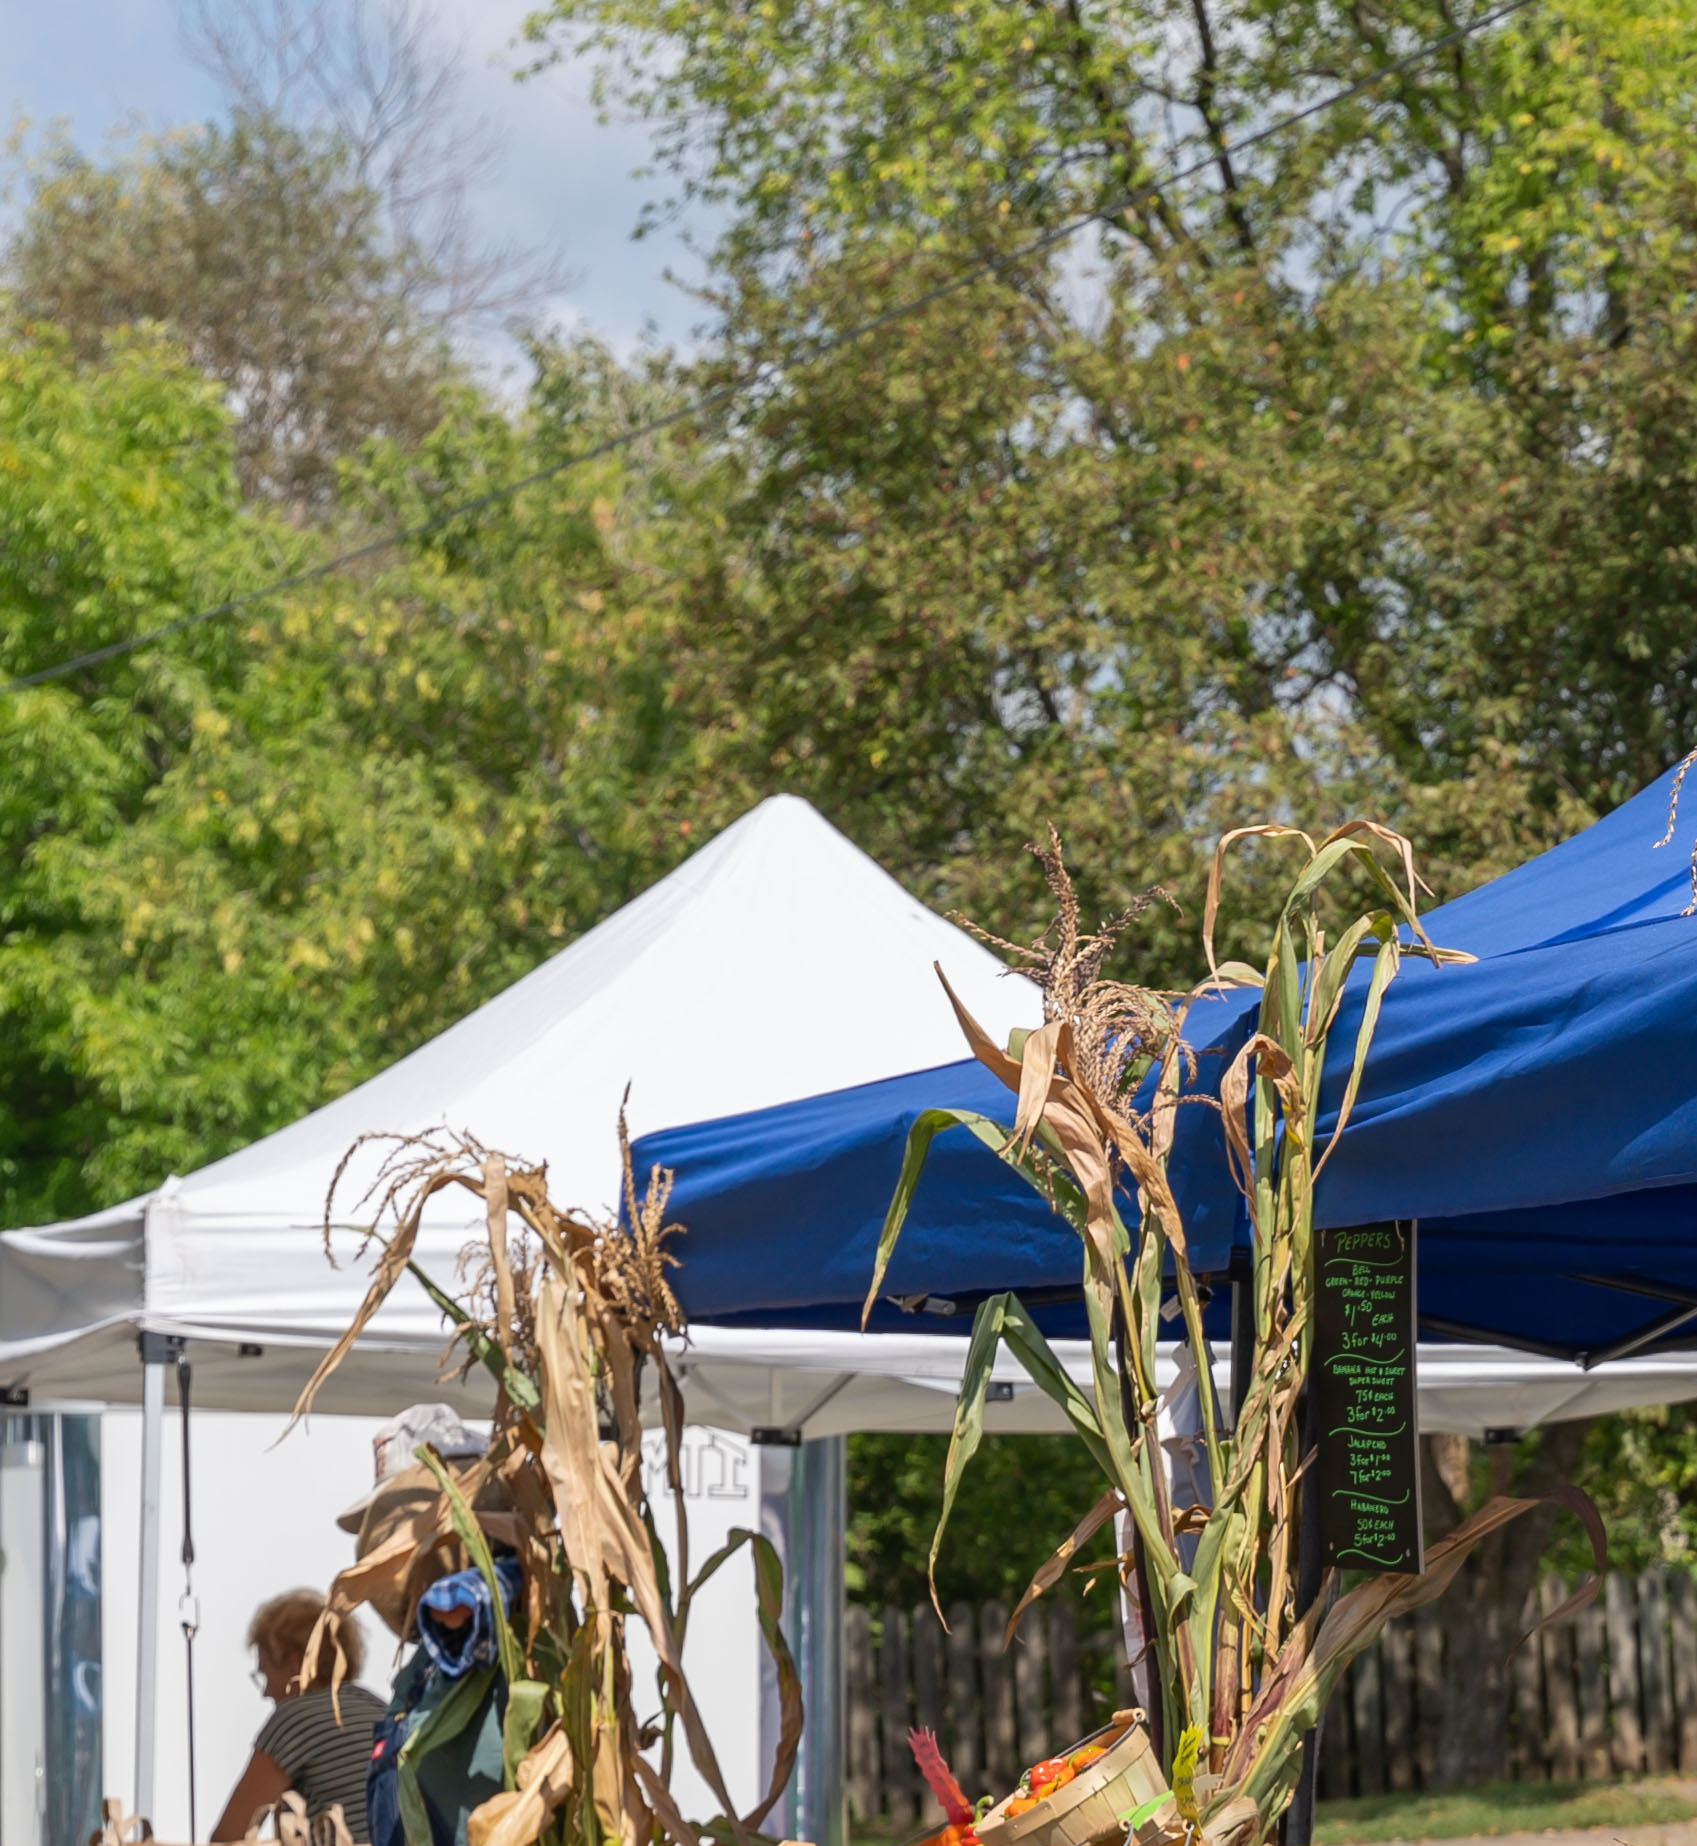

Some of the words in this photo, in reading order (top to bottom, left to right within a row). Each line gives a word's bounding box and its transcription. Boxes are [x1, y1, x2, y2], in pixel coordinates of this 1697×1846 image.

[1334, 1231, 1391, 1253] PEPPERS
[1352, 1264, 1371, 1276] BELL
[1370, 1290, 1396, 1300] YELLOW
[1372, 1313, 1394, 1326] EACH
[1374, 1519, 1395, 1530] EACH
